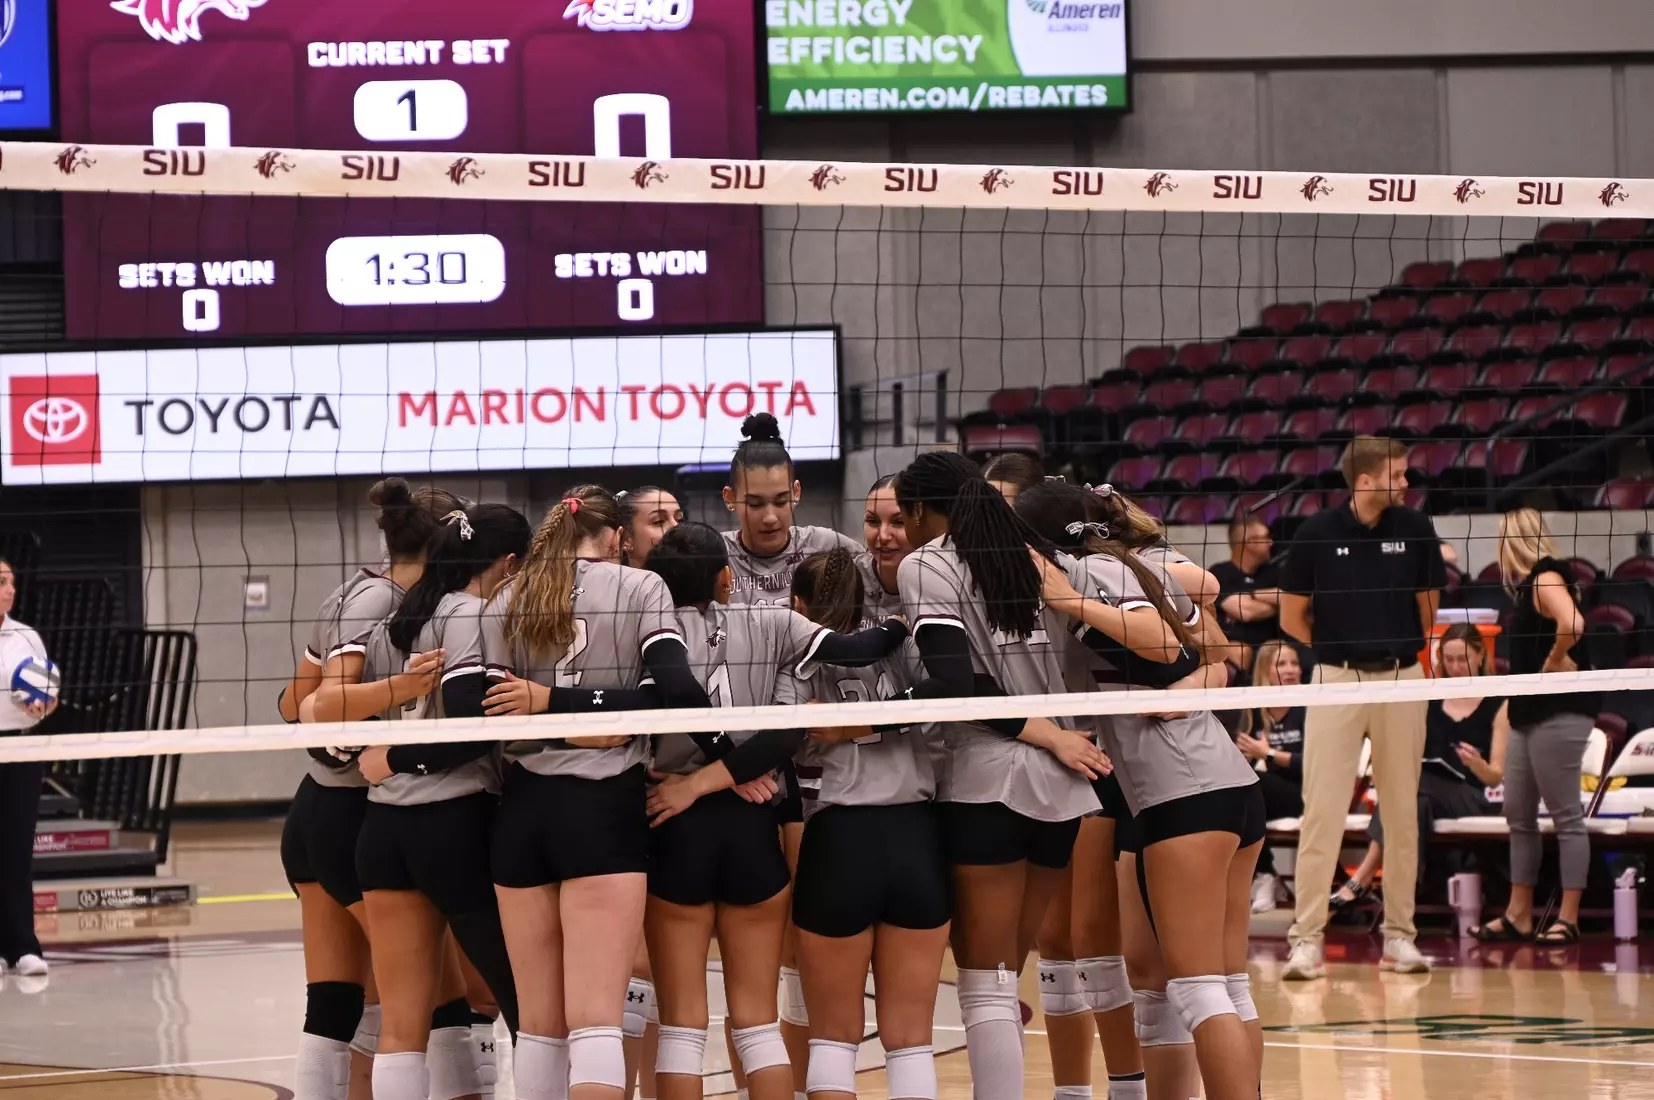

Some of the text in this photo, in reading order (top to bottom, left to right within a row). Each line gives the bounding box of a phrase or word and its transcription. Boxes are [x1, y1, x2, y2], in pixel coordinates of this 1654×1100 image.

[590, 0, 691, 27] SEMO
[766, 0, 912, 26] ENERGY
[1048, 1, 1121, 19] Ameren
[307, 39, 510, 67] CURRENT SET
[768, 35, 983, 64] EFFICIENCY
[396, 88, 417, 131] 1
[785, 82, 1108, 112] AMEREN.COM/REBATES
[143, 150, 206, 176] SIU
[341, 155, 400, 181] SIU
[528, 161, 585, 187] SIU
[710, 165, 766, 190] SIU
[884, 167, 938, 192] SIU
[1052, 170, 1104, 195] SIU
[1212, 174, 1263, 199] SIU
[1368, 178, 1416, 202] SIU
[1516, 181, 1564, 205] SIU
[118, 260, 276, 288] SETS WON
[364, 251, 468, 286] 1:30
[554, 250, 707, 278] SETS WON
[182, 288, 220, 332] 0
[617, 278, 654, 321] 0
[124, 394, 340, 436] TOYOTA
[398, 380, 816, 427] MARION TOYOTA
[729, 571, 780, 596] OUTHERN
